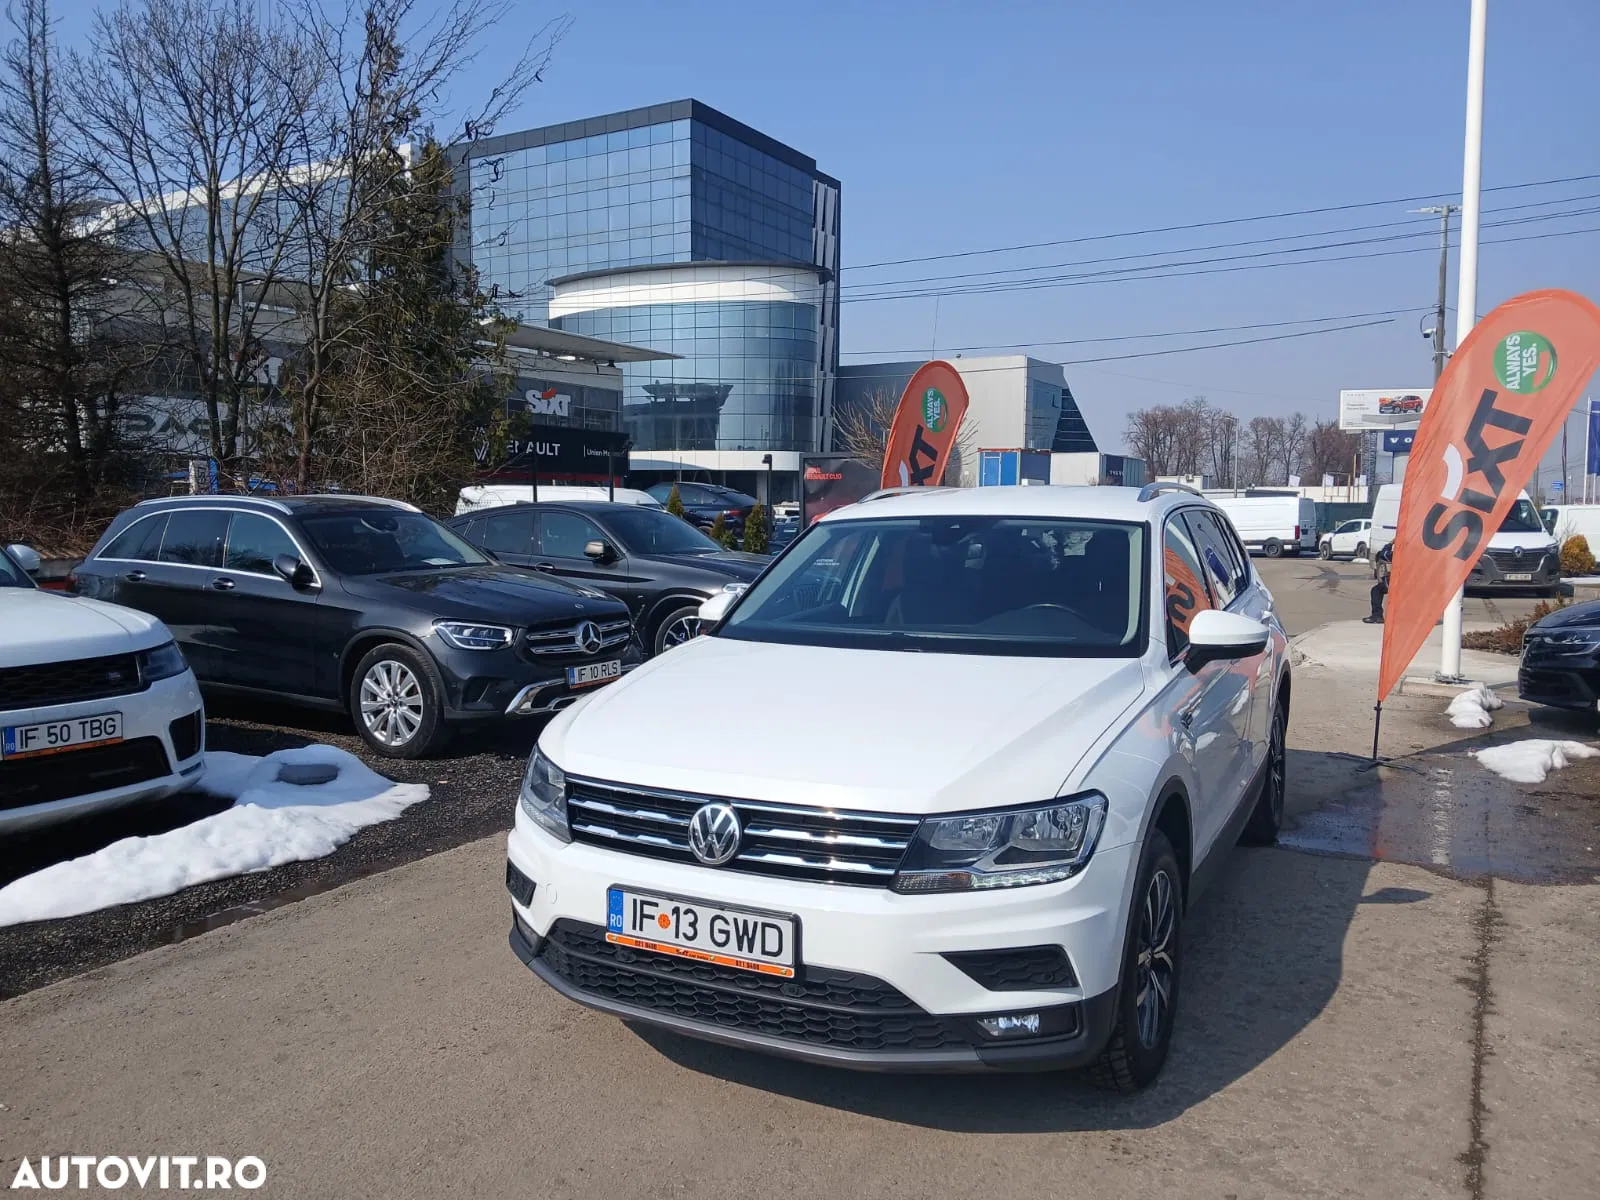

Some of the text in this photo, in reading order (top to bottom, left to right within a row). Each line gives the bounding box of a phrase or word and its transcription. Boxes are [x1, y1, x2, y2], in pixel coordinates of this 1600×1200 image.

[1506, 335, 1521, 390] ALWAYS
[1522, 343, 1537, 377] YES.
[1422, 388, 1533, 561] SIXT
[578, 667, 587, 681] IF
[590, 665, 598, 679] 10
[601, 662, 618, 677] RLS
[20, 727, 39, 749] IF
[47, 724, 71, 744] 50
[79, 717, 117, 740] TBG
[610, 898, 783, 957] RO IF 13 GWD
